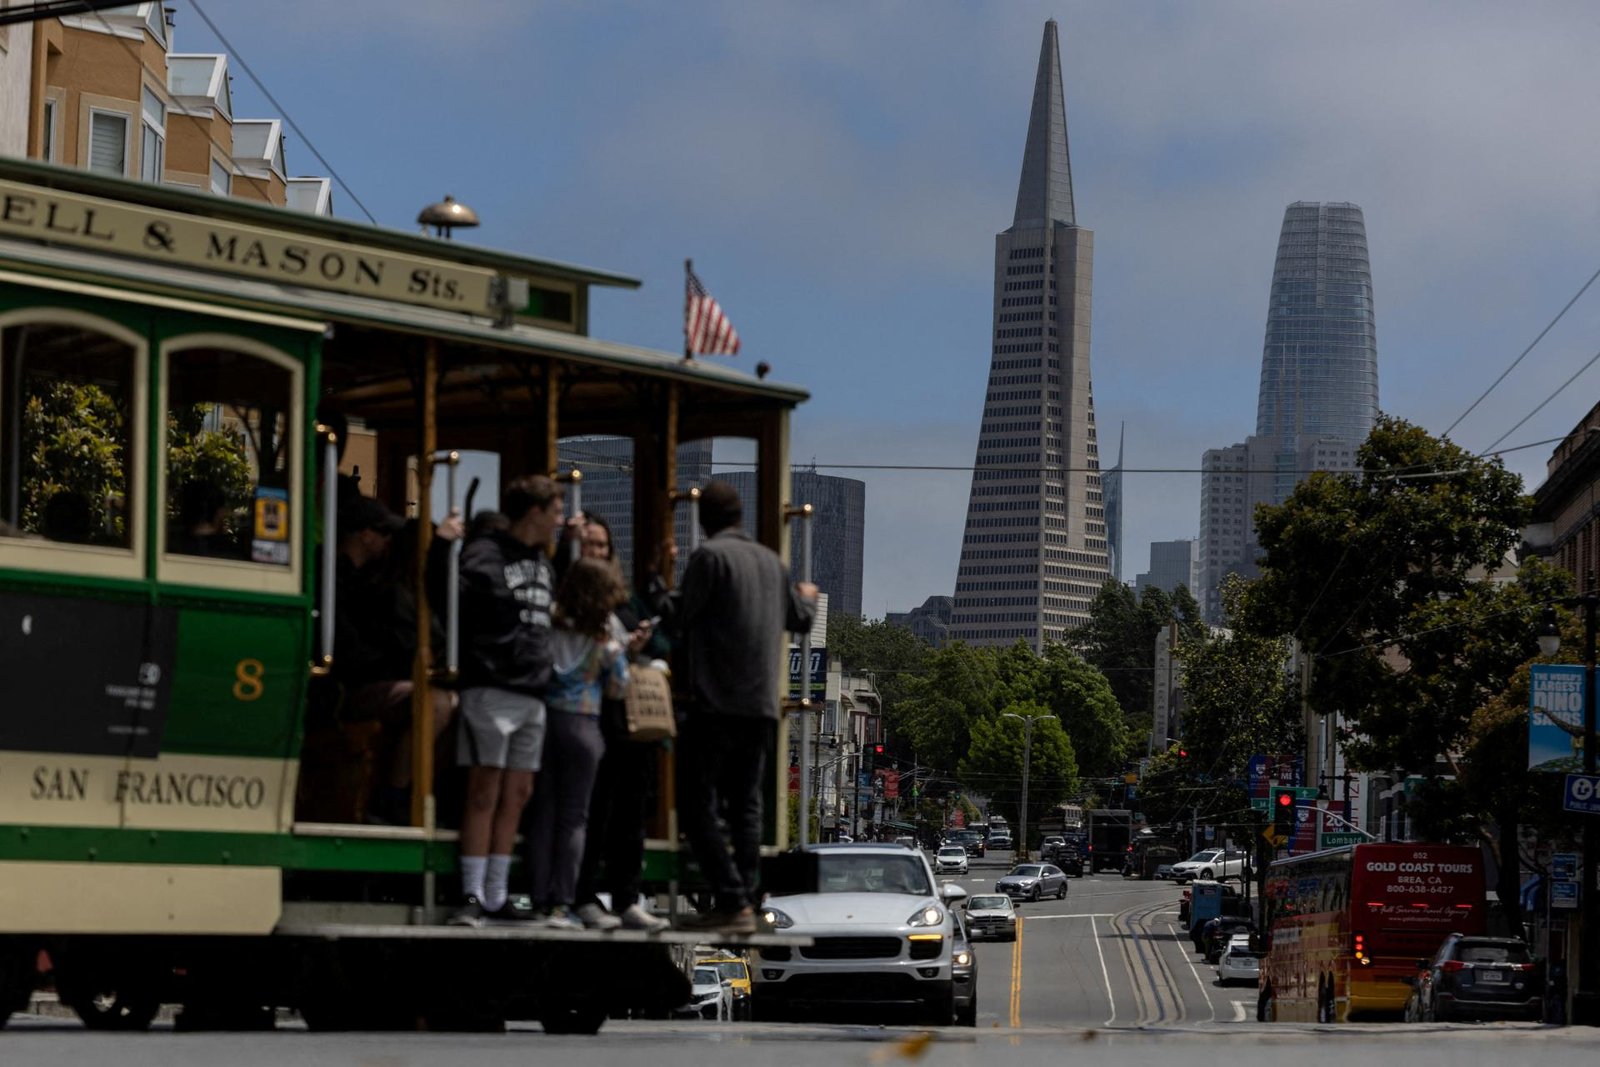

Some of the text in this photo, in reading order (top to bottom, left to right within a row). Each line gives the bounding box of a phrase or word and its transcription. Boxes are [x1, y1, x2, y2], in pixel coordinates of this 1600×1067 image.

[1, 193, 464, 301] ELL & MASON Sts.
[232, 658, 265, 702] 8
[1533, 680, 1583, 692] LARGEST
[1533, 691, 1582, 712] DINO
[30, 765, 266, 810] SAN FRANCISCO
[1326, 836, 1362, 845] Lombard
[1366, 861, 1473, 874] GOLD COAST TOURS
[1397, 875, 1442, 885] BREA, CA
[1386, 884, 1454, 894] 800-638-6427
